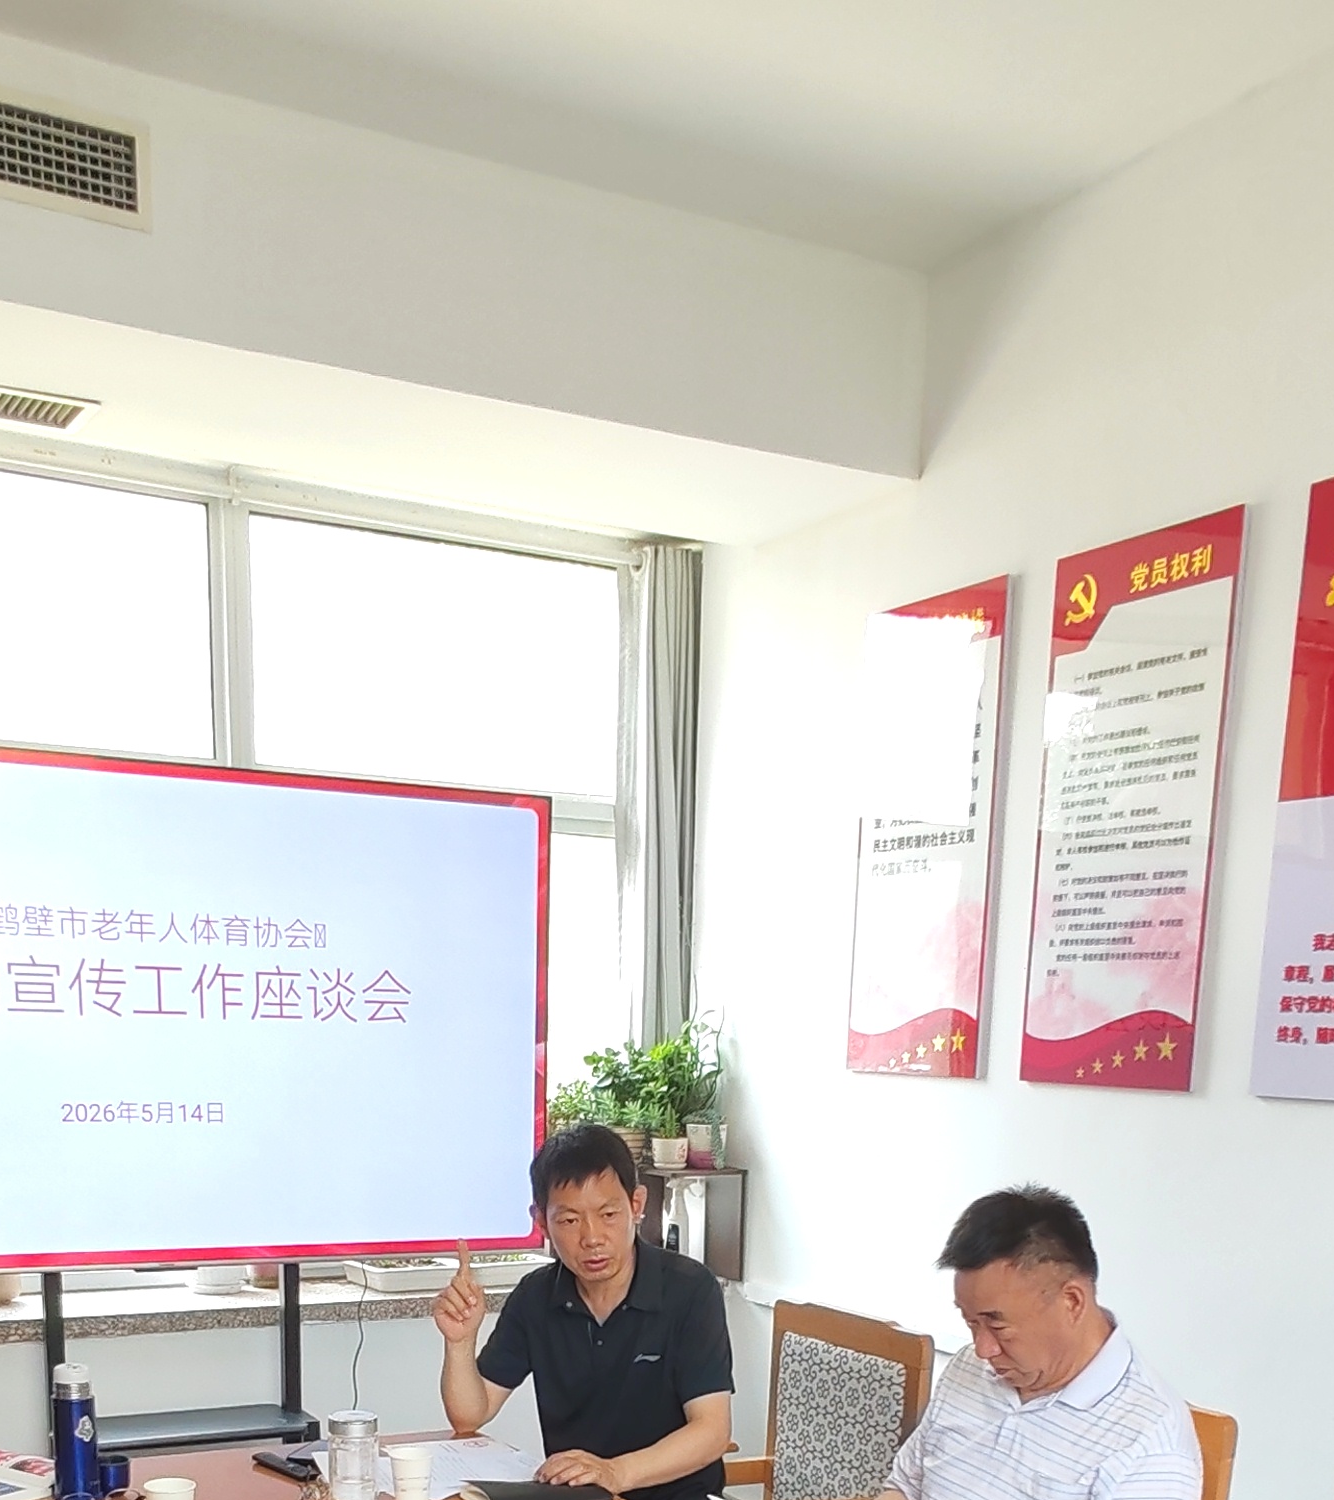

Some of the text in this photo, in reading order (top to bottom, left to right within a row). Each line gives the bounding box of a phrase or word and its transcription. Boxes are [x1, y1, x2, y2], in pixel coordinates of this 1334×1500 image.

[1129, 544, 1213, 594] 党员权利
[61, 1101, 225, 1126] 2026年5月14日
